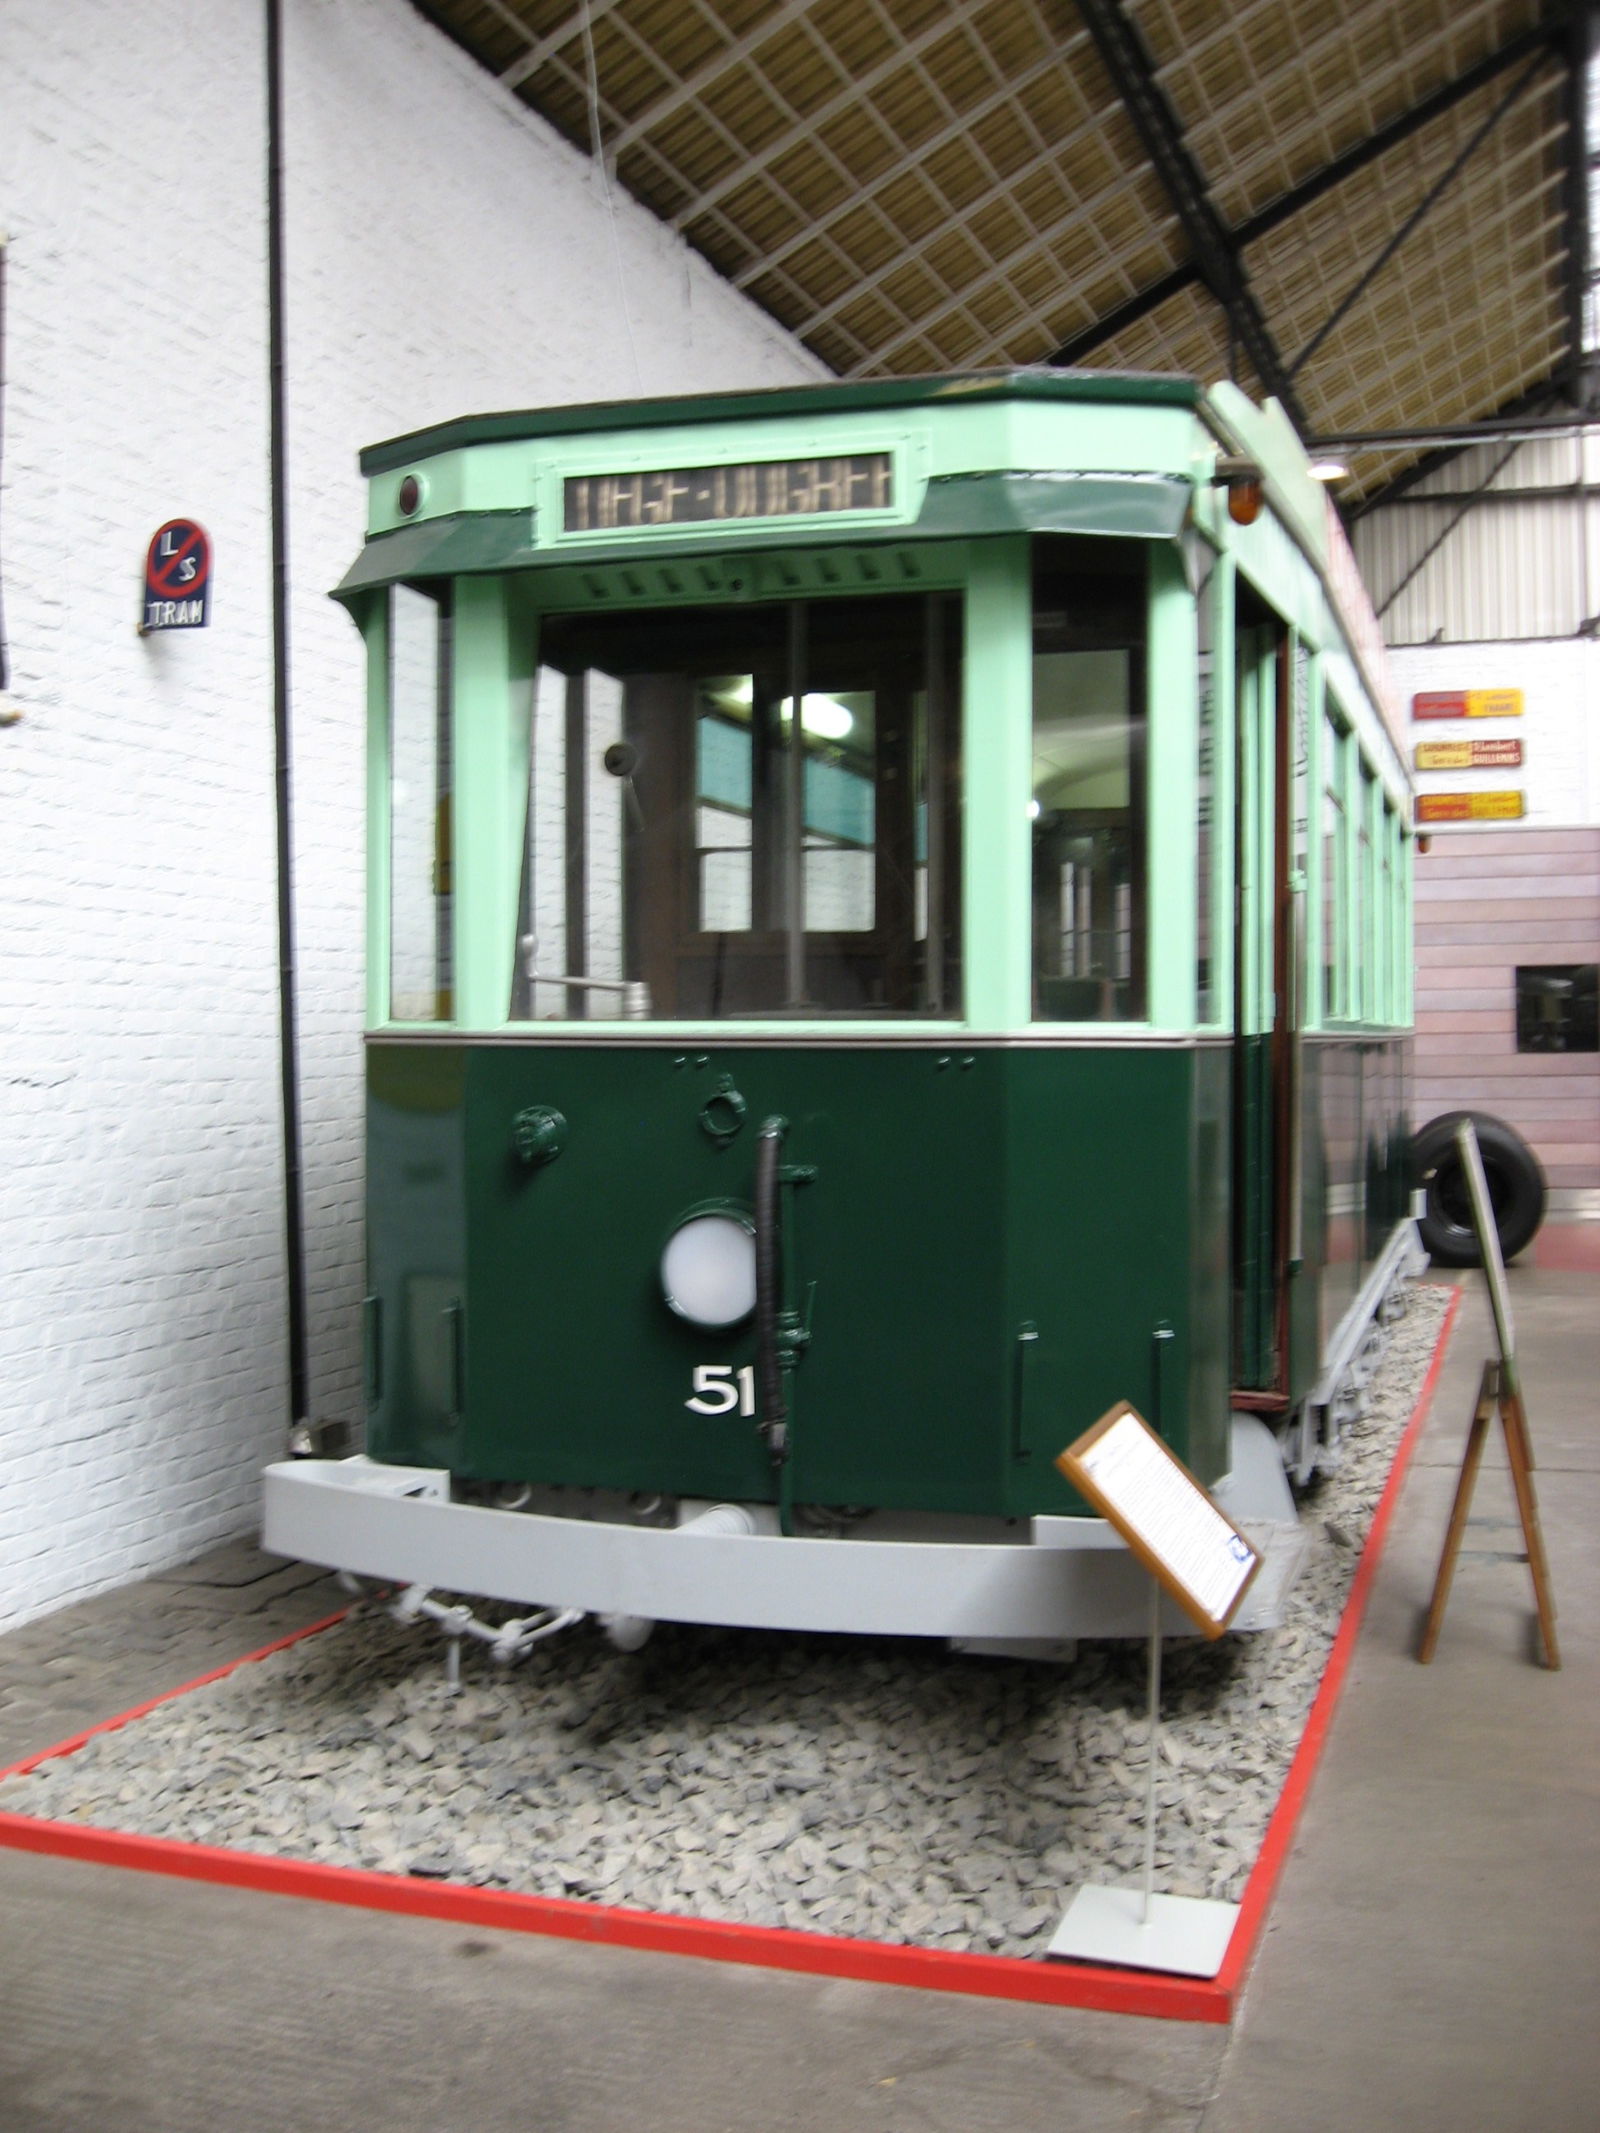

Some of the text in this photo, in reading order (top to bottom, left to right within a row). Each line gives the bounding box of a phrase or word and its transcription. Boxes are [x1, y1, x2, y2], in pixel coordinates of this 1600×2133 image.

[160, 531, 179, 556] L
[179, 556, 197, 582] S
[147, 600, 204, 626] TRAM
[684, 1364, 756, 1417] 51
